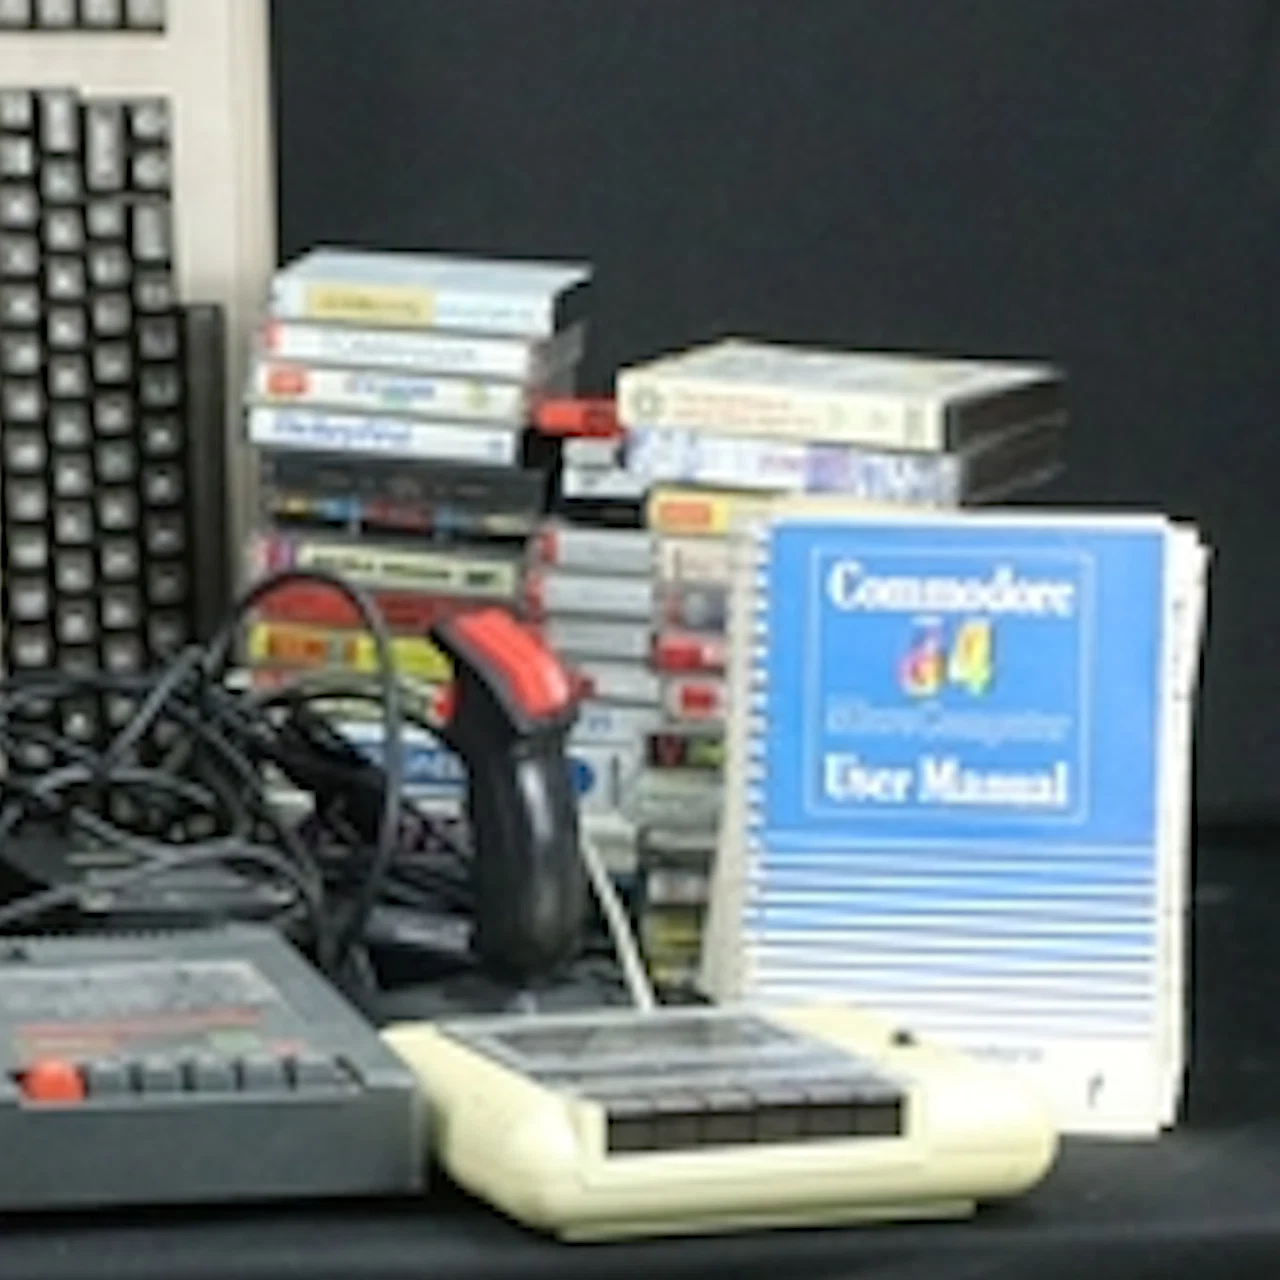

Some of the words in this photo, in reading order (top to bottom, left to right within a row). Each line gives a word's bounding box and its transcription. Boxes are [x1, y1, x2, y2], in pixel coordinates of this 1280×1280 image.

[825, 558, 1076, 618] Commodore
[823, 752, 914, 804] User
[917, 754, 1070, 807] Manual
